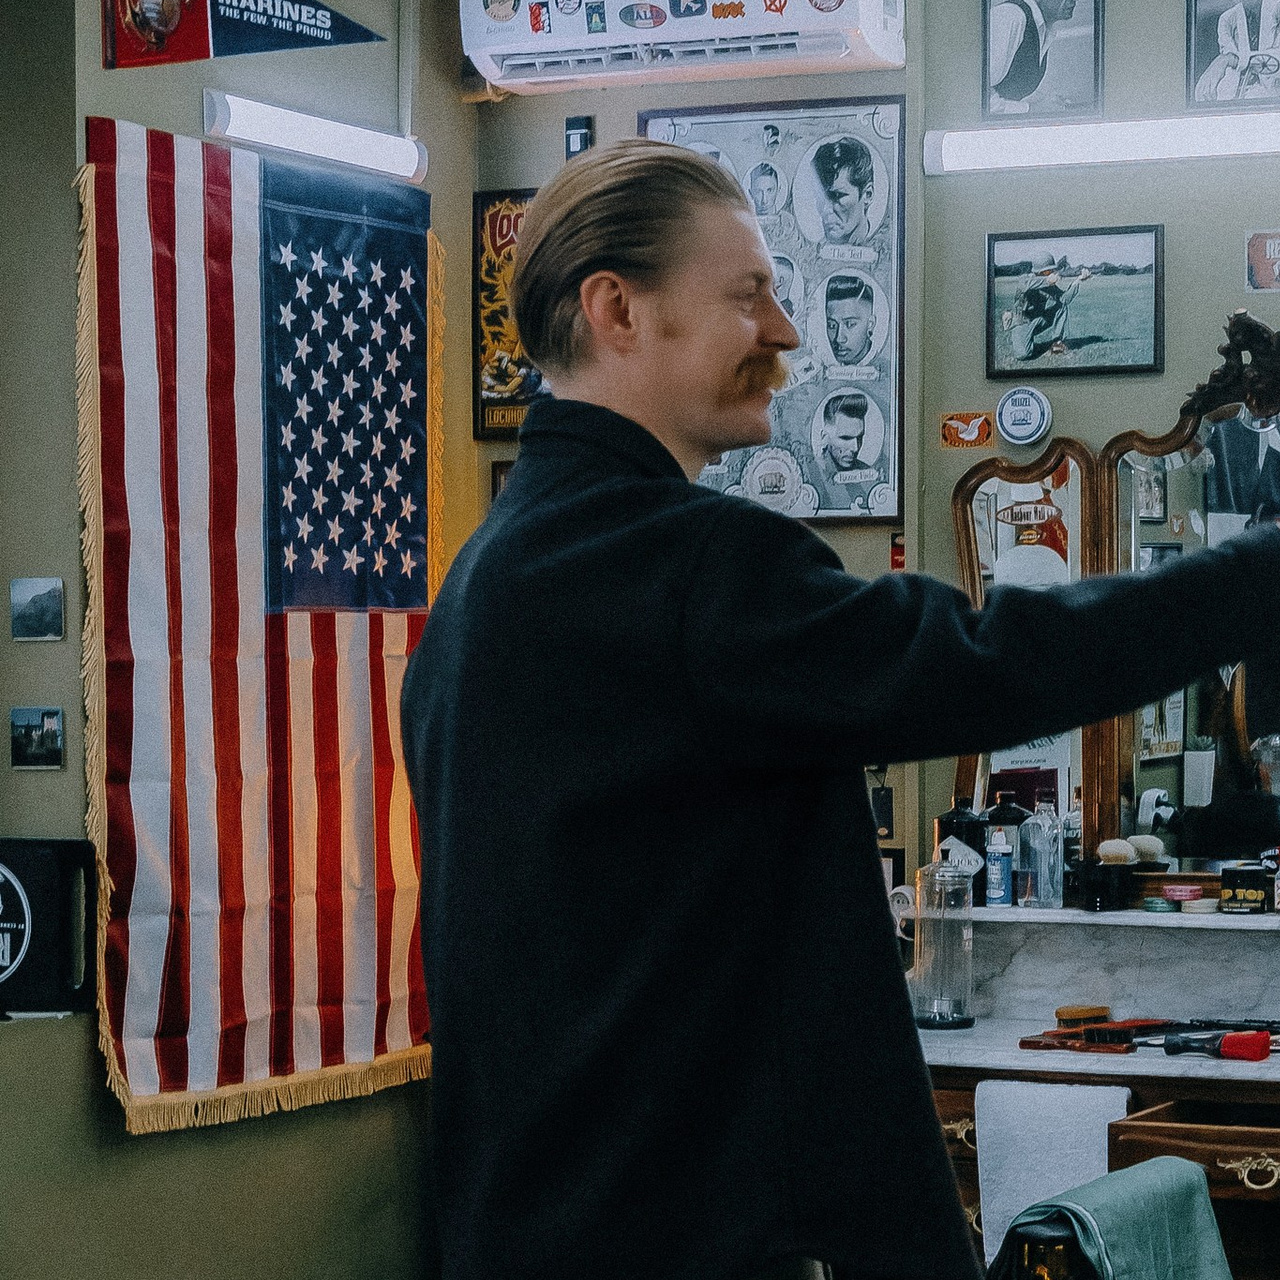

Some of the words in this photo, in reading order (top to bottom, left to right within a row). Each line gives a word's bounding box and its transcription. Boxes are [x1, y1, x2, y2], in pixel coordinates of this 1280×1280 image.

[218, 5, 240, 20] THE
[271, 17, 293, 32] THE
[295, 23, 332, 41] PROUD
